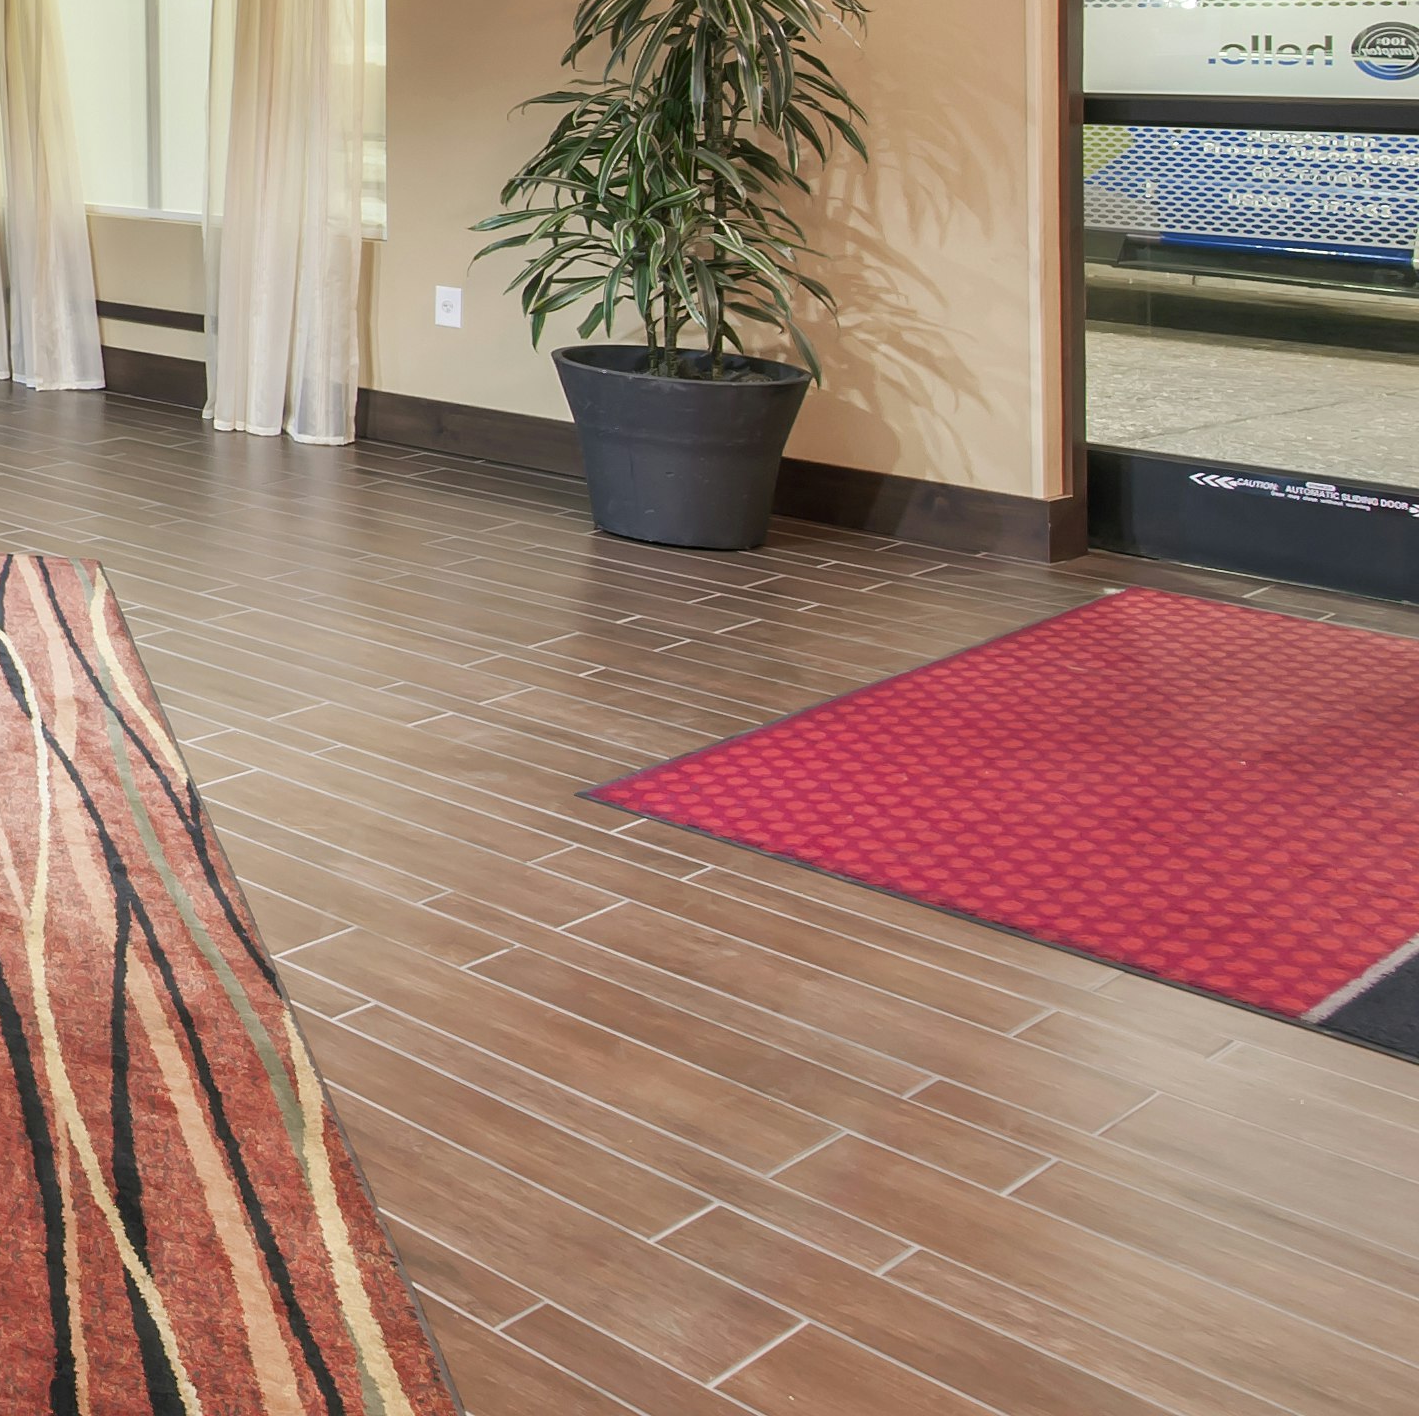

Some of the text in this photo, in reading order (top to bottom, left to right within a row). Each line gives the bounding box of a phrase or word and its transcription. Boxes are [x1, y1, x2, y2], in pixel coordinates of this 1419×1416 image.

[1285, 485, 1340, 500] AUTOMATIC
[1341, 493, 1379, 506] SLIDING
[1380, 498, 1409, 511] DOOR
